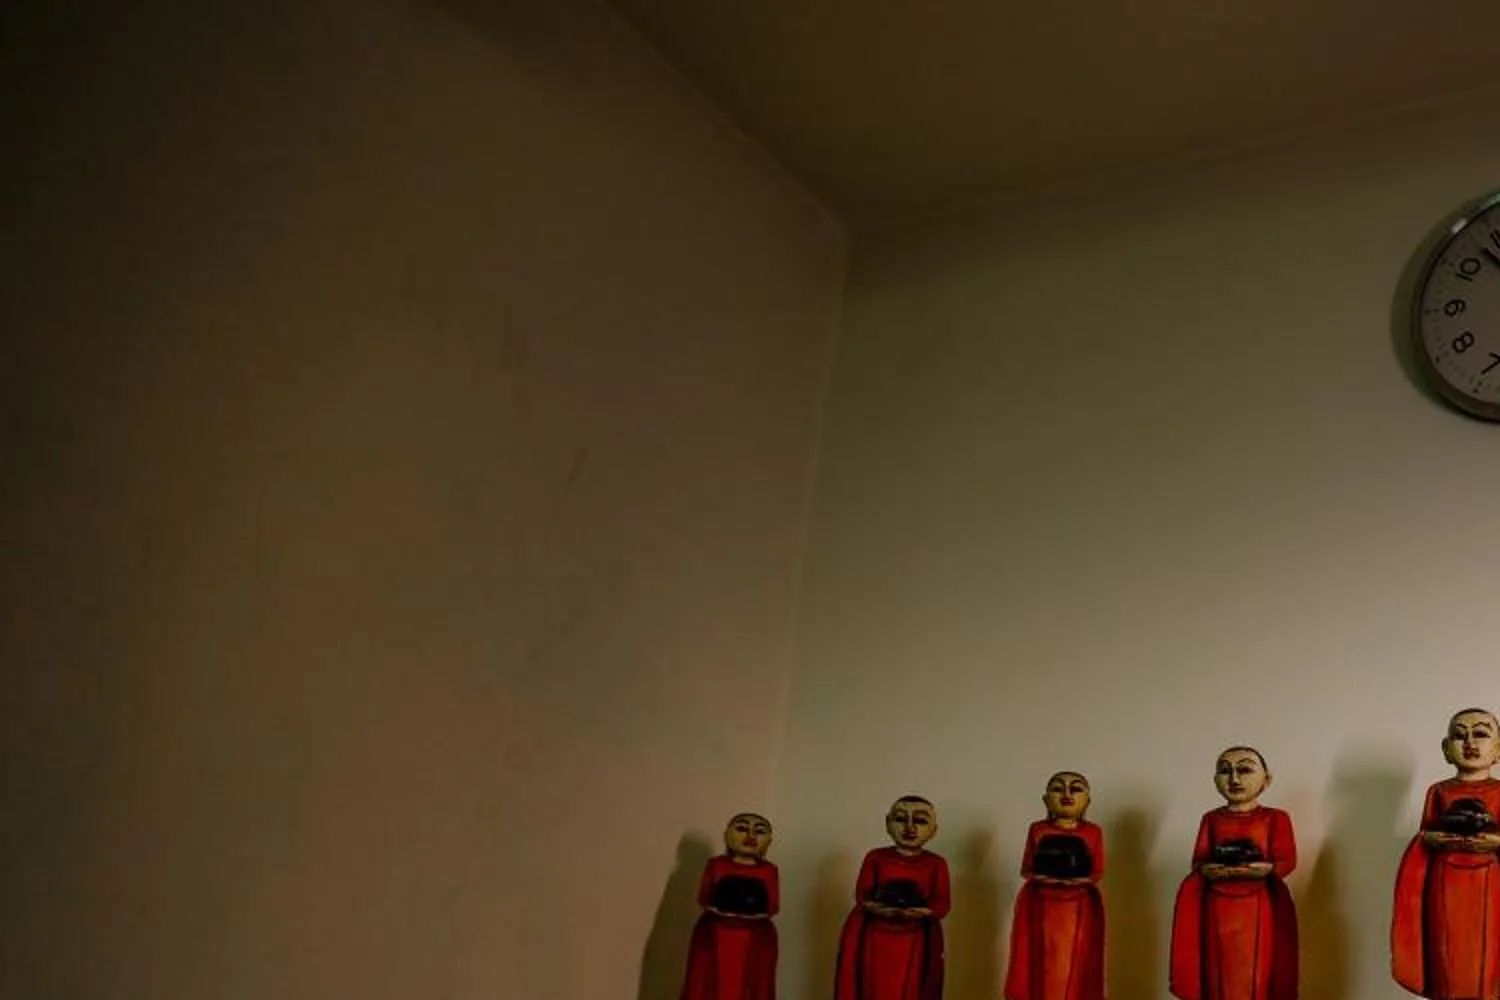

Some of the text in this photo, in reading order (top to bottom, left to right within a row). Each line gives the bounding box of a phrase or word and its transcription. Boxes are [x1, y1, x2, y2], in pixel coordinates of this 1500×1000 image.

[1455, 256, 1481, 282] 10
[1443, 298, 1466, 318] 9
[1452, 331, 1475, 354] 8
